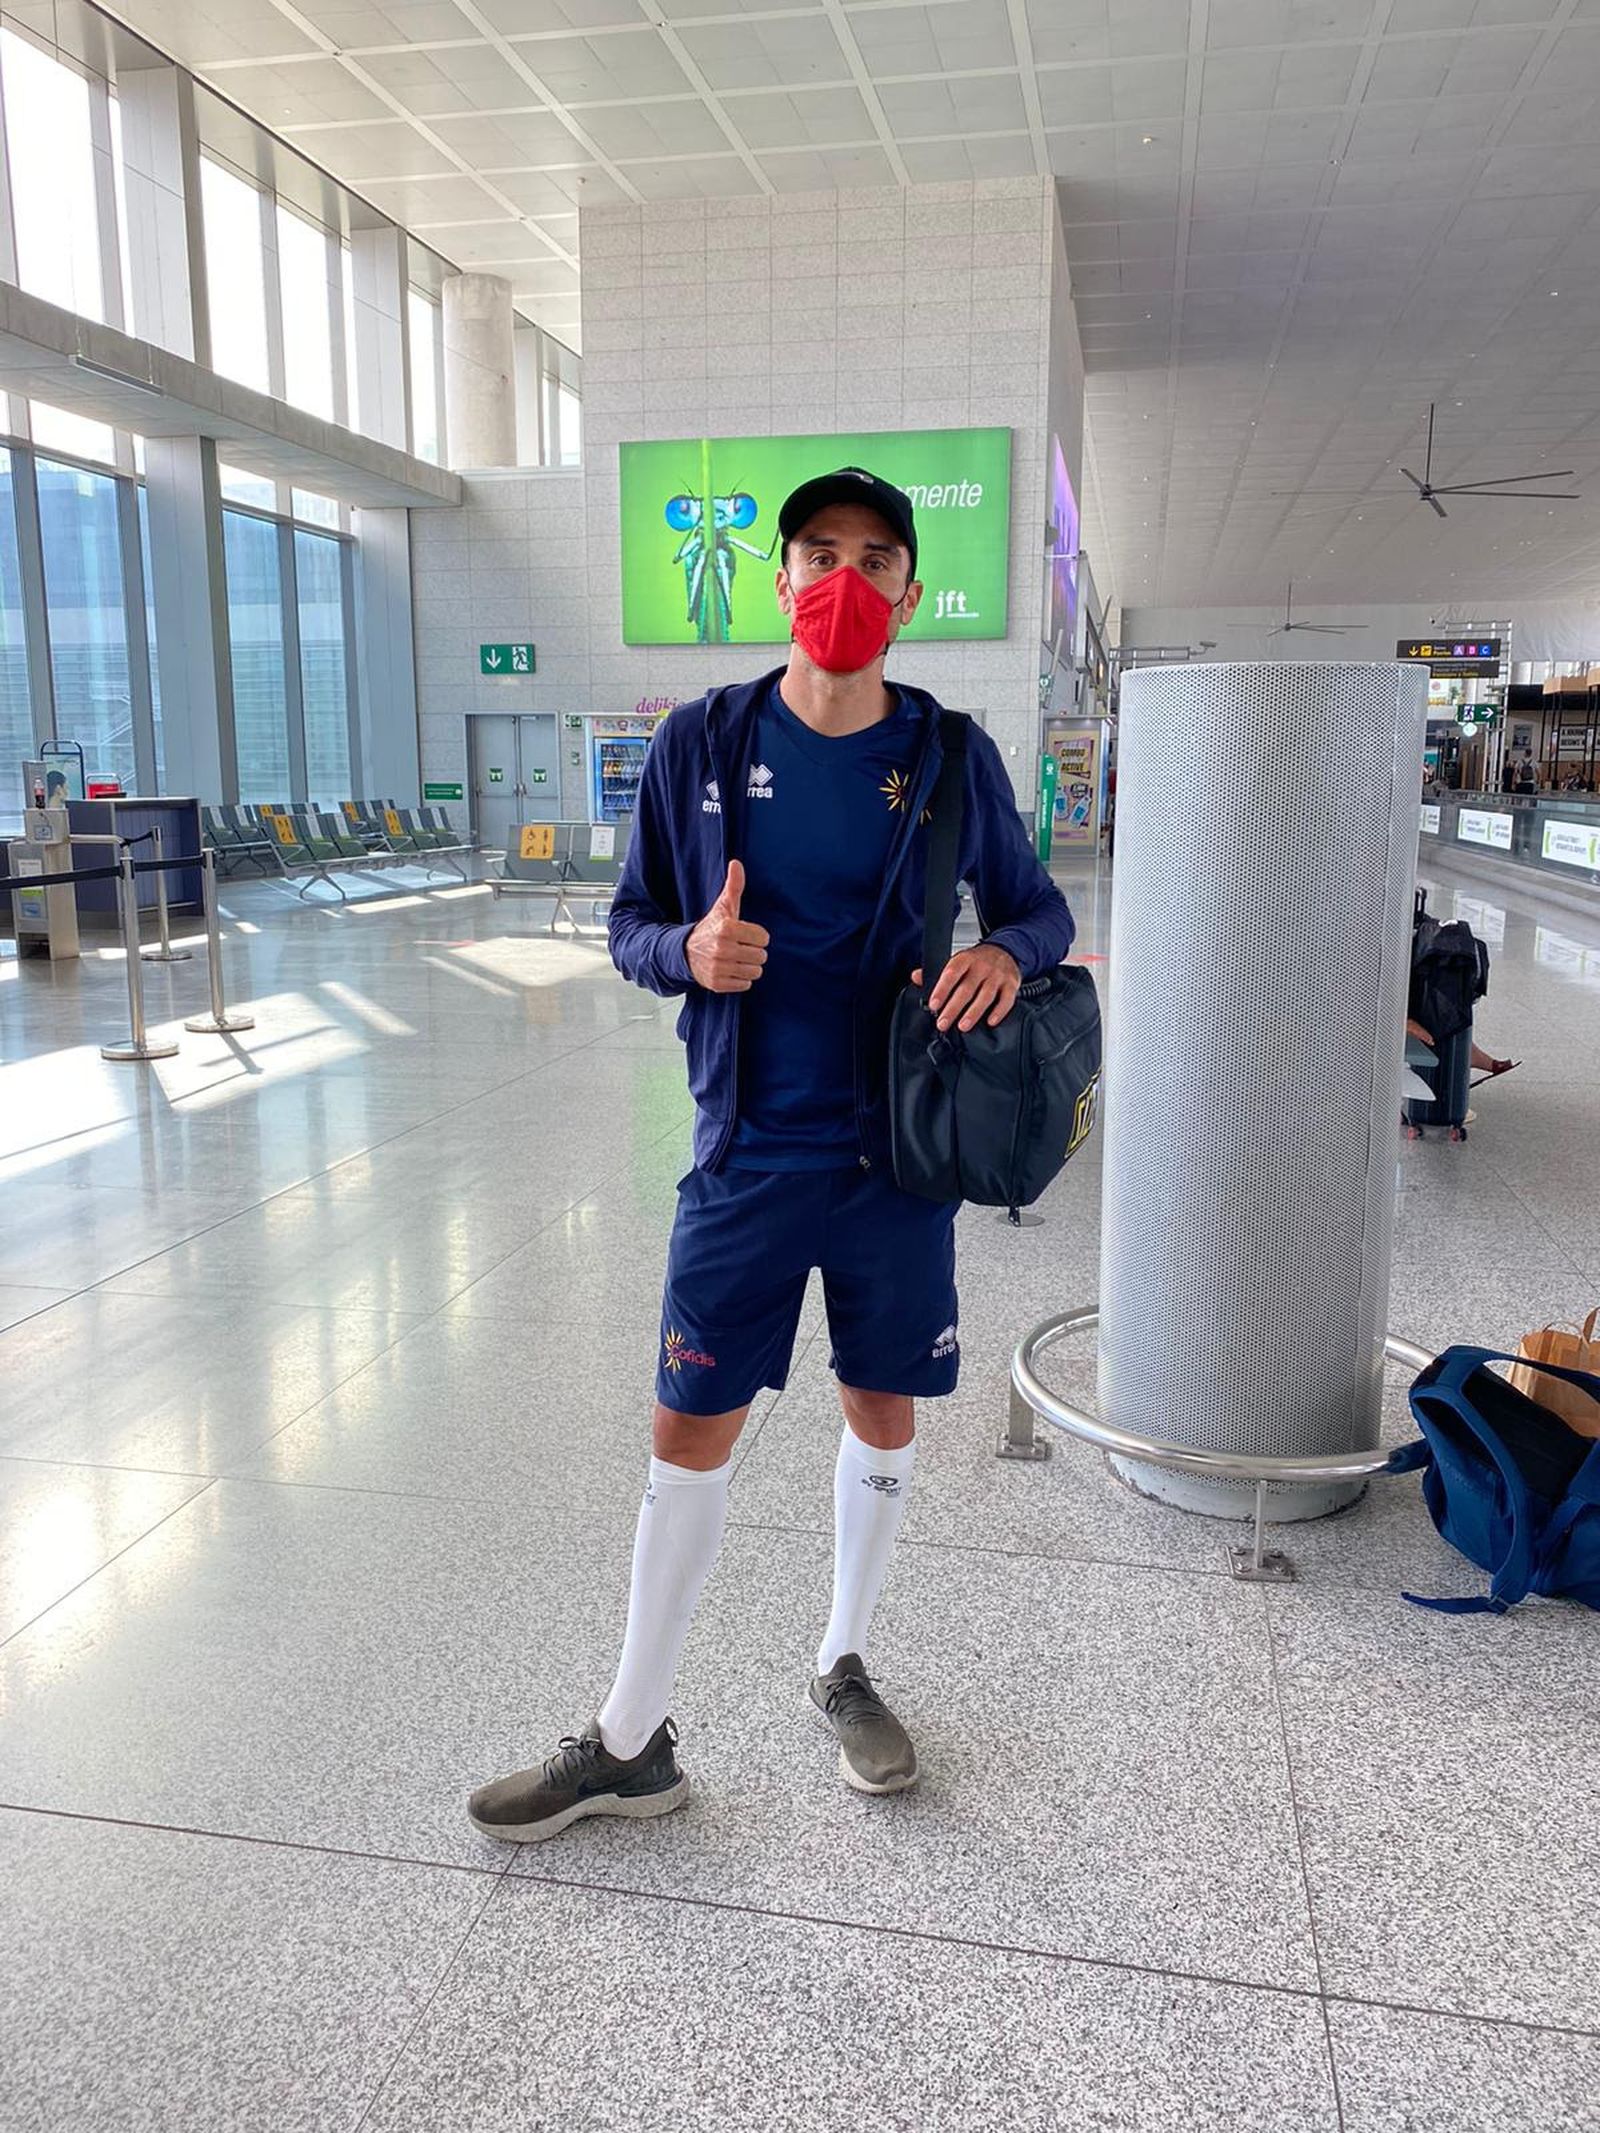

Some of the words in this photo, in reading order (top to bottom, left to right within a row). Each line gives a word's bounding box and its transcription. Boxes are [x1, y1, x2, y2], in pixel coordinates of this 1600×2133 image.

[904, 478, 983, 508] mente
[934, 590, 967, 619] jft
[1482, 646, 1490, 655] C
[746, 786, 773, 798] rrea
[671, 1344, 716, 1367] Cofidis
